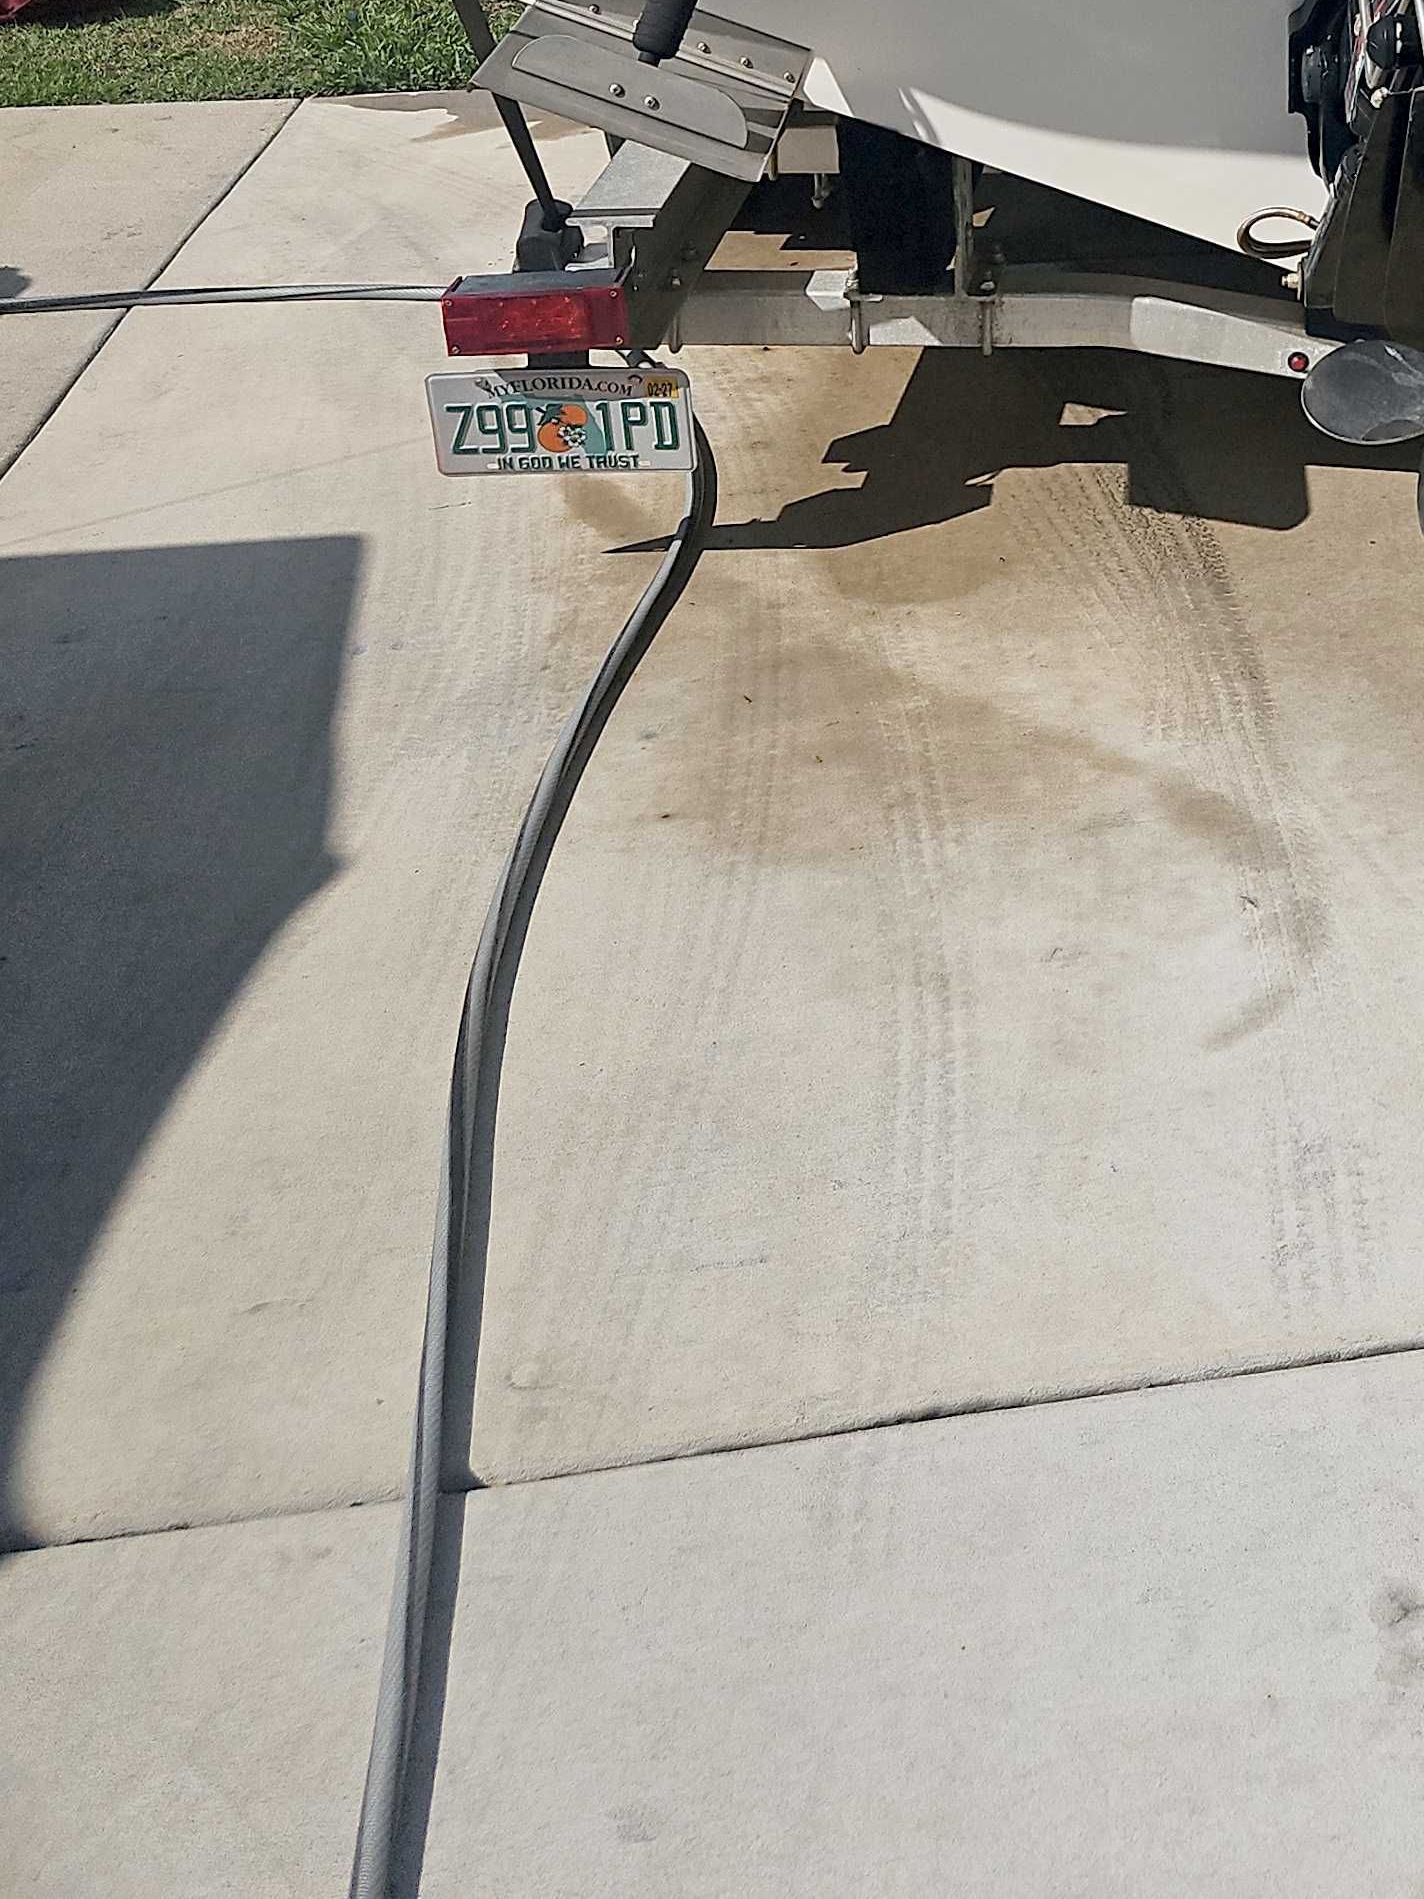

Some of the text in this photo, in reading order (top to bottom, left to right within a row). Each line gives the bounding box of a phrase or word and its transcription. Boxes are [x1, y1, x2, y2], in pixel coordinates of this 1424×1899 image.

[488, 376, 633, 399] MYFLORIDA.COM
[445, 400, 680, 455] Z99 1PD
[497, 453, 640, 470] IN GOD WE TRUST
